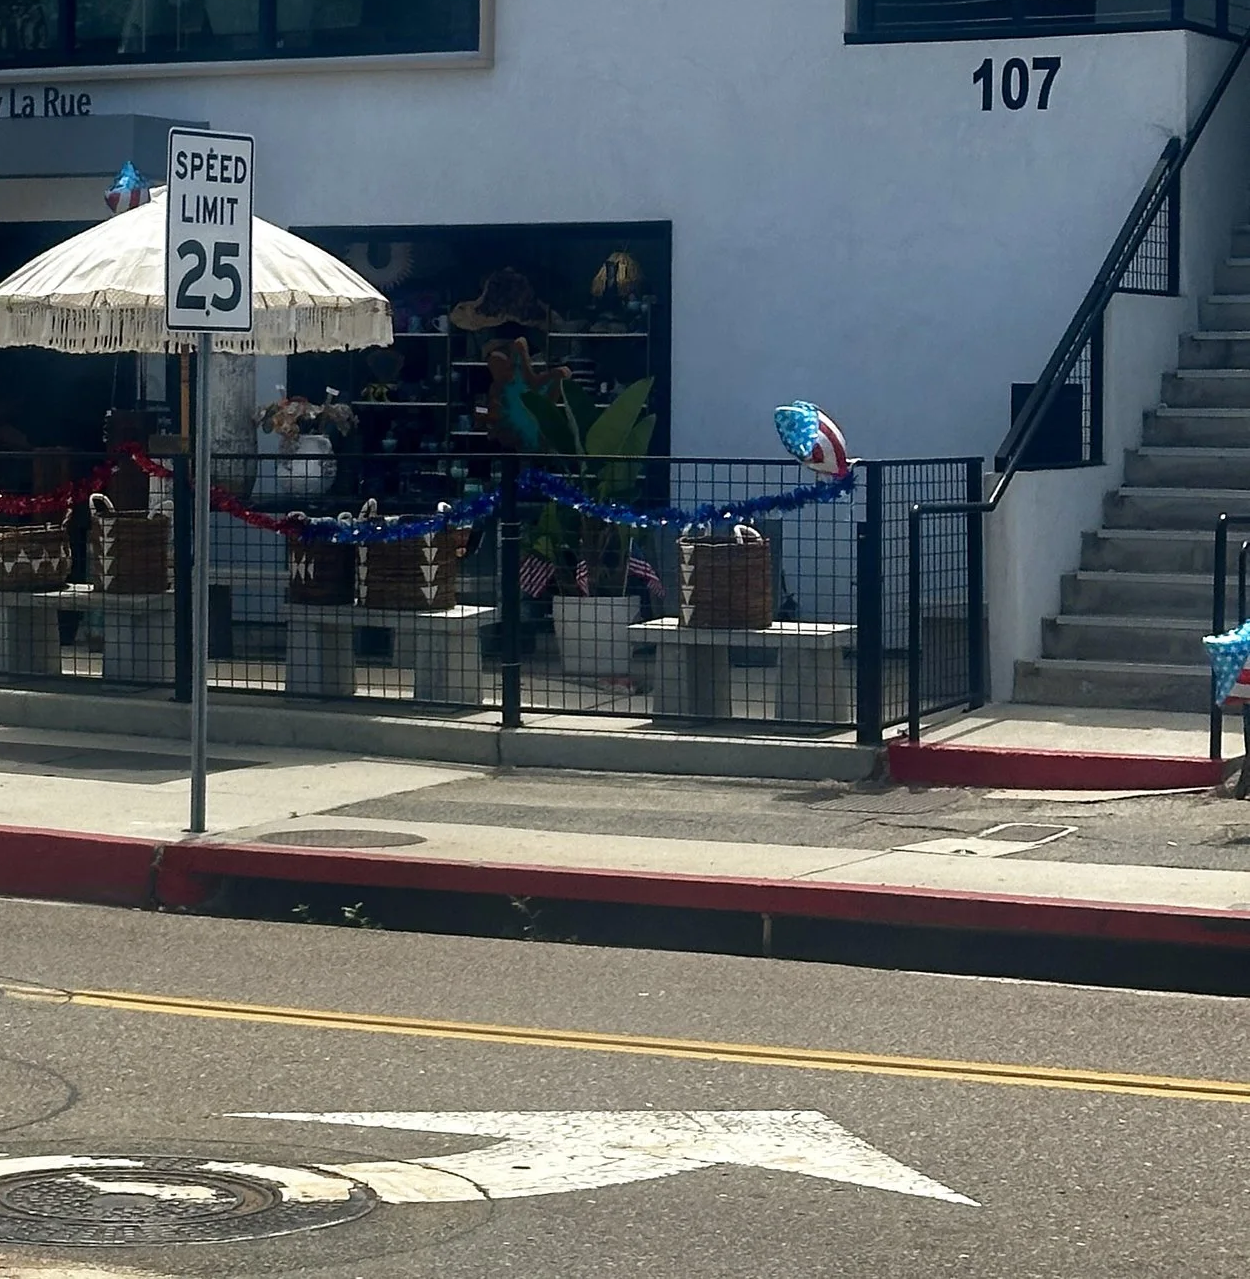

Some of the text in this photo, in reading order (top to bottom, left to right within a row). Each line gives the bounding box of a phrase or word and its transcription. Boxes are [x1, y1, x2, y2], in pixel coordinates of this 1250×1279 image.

[973, 56, 1061, 111] 107
[10, 87, 35, 118] La
[44, 86, 92, 118] Rue
[175, 150, 247, 184] SPEED
[181, 193, 239, 226] LIMIT
[175, 239, 243, 312] 25
